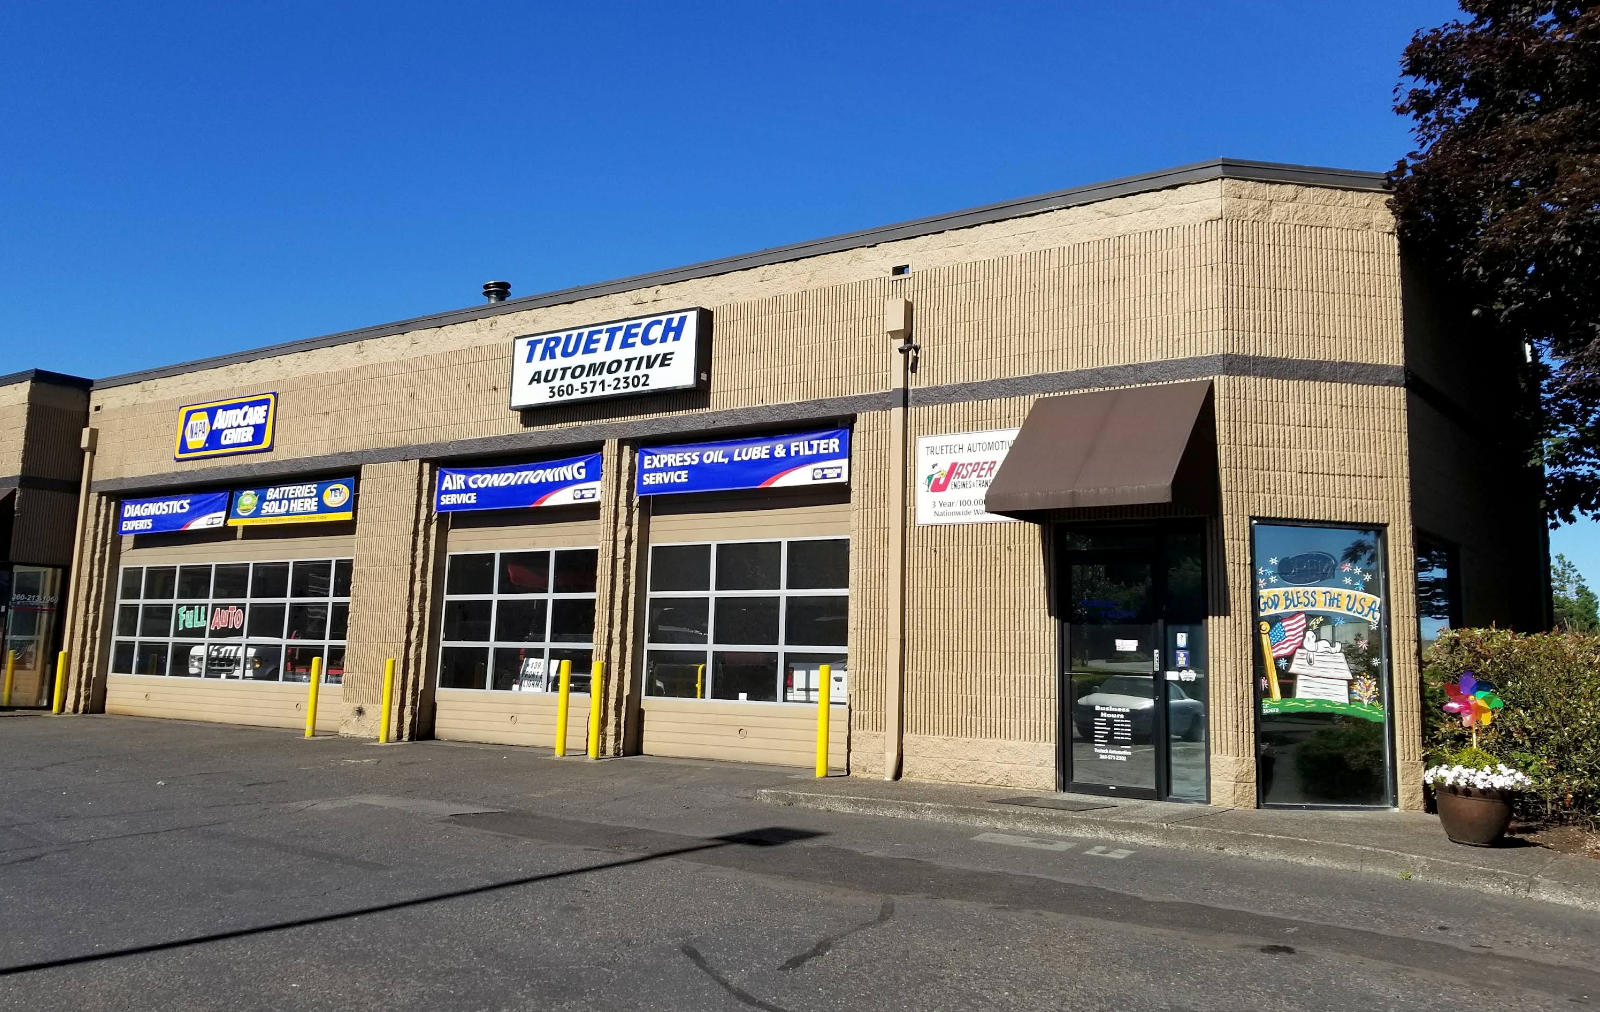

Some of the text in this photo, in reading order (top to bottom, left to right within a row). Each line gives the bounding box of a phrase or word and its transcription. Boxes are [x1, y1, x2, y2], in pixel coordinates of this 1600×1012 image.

[525, 315, 688, 363] TRUETECH
[528, 351, 675, 385] AUTOMOTIVE
[548, 373, 650, 399] 360-571-2302
[189, 421, 206, 440] NAPA
[220, 426, 255, 445] CENTER
[643, 437, 840, 469] EXPRESS OIL, LUBE & FILTER
[925, 440, 1014, 456] TRUETECH AUTOMOTIV
[441, 461, 587, 491] AIR CONDITIONING
[642, 470, 689, 486] SERVICE
[930, 461, 997, 493] JASPER
[266, 484, 318, 500] BATTERIES
[440, 492, 477, 506] SERVICE
[123, 500, 191, 518] DIAGNOSTICS
[260, 497, 319, 514] SOLD HERE
[121, 519, 153, 531] EXPERTS
[1259, 594, 1280, 613] GOD
[1283, 590, 1317, 610] BLESS
[1321, 590, 1342, 608] THE
[178, 605, 207, 631] FULL
[210, 606, 243, 630] AUTO
